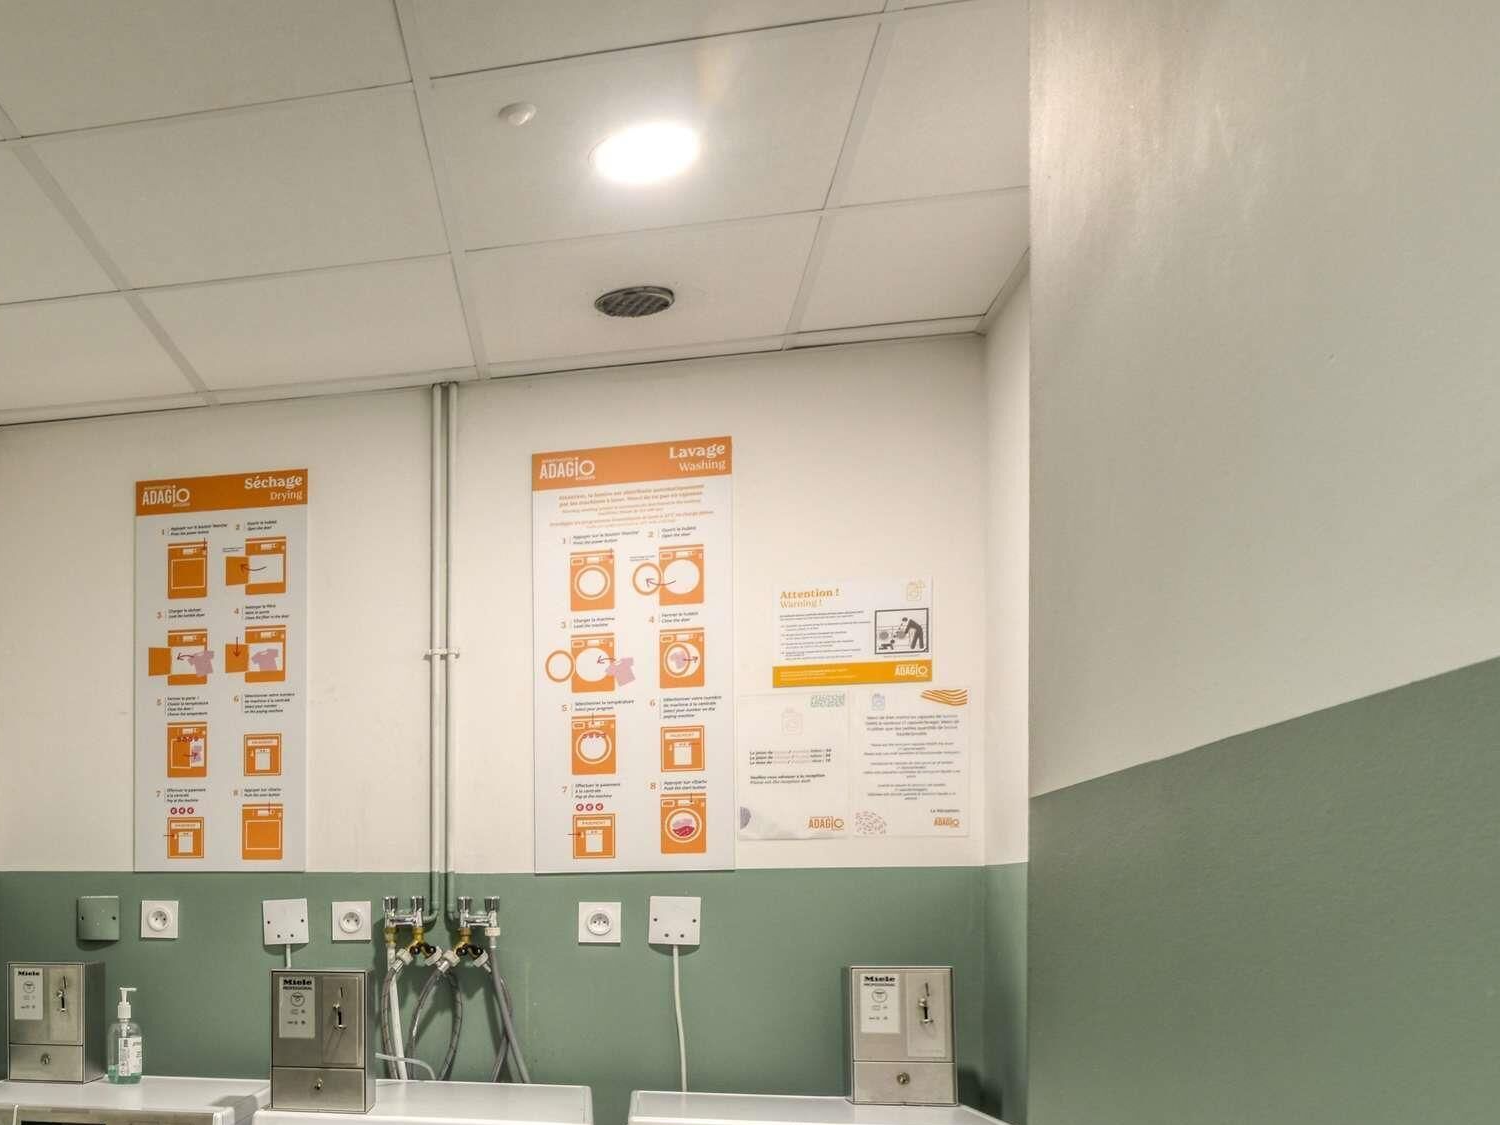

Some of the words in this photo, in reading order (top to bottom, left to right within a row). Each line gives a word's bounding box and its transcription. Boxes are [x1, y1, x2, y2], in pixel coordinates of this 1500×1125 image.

[669, 444, 725, 459] Lavage
[679, 459, 726, 473] Washing
[244, 475, 302, 490] Séchage
[270, 490, 302, 502] Drying
[780, 589, 833, 599] Attention
